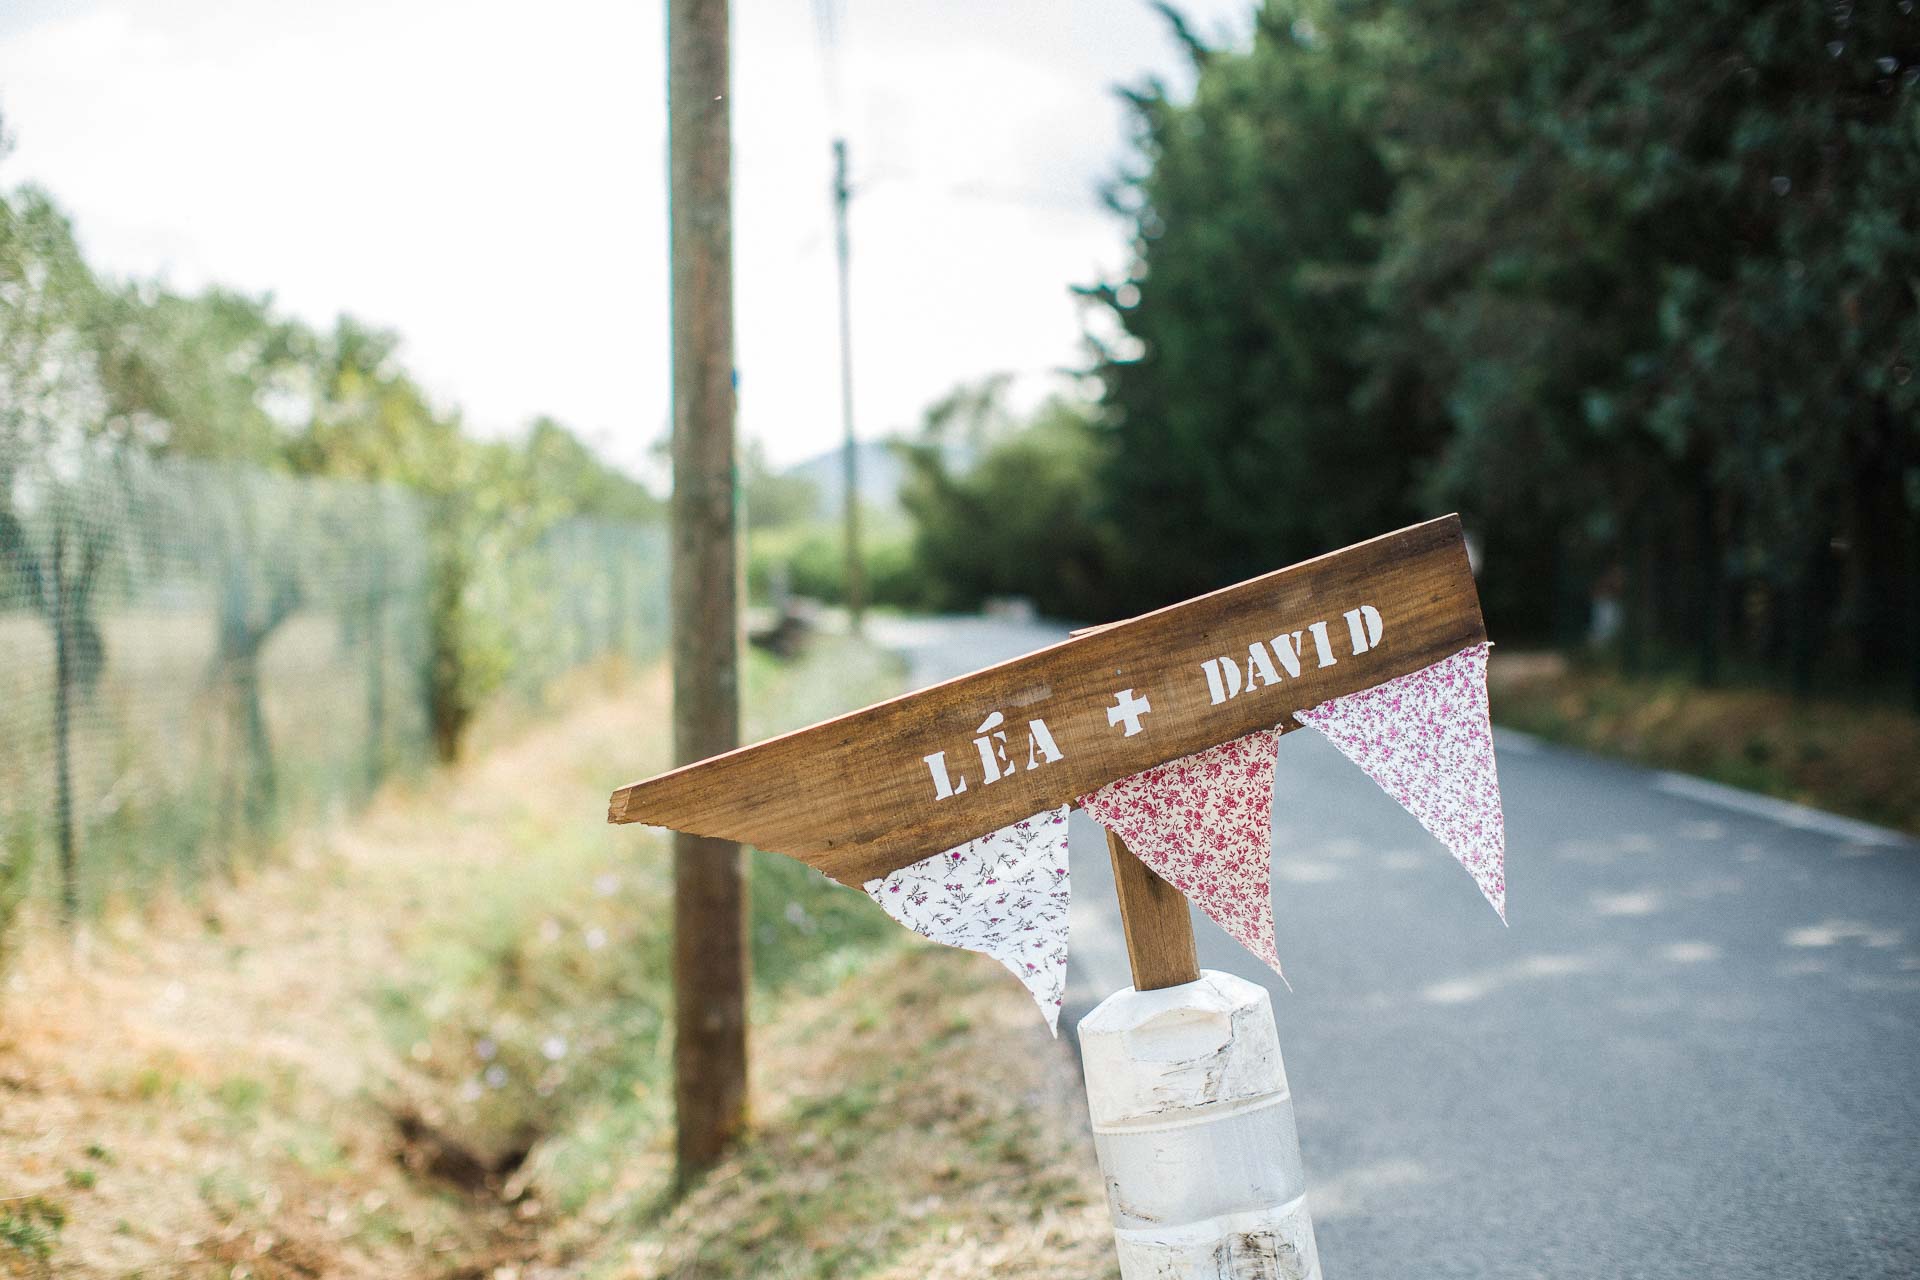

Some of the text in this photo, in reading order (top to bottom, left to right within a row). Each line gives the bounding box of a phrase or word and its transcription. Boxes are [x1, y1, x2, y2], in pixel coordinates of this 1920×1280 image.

[923, 605, 1384, 801] LÉA + DAVID
